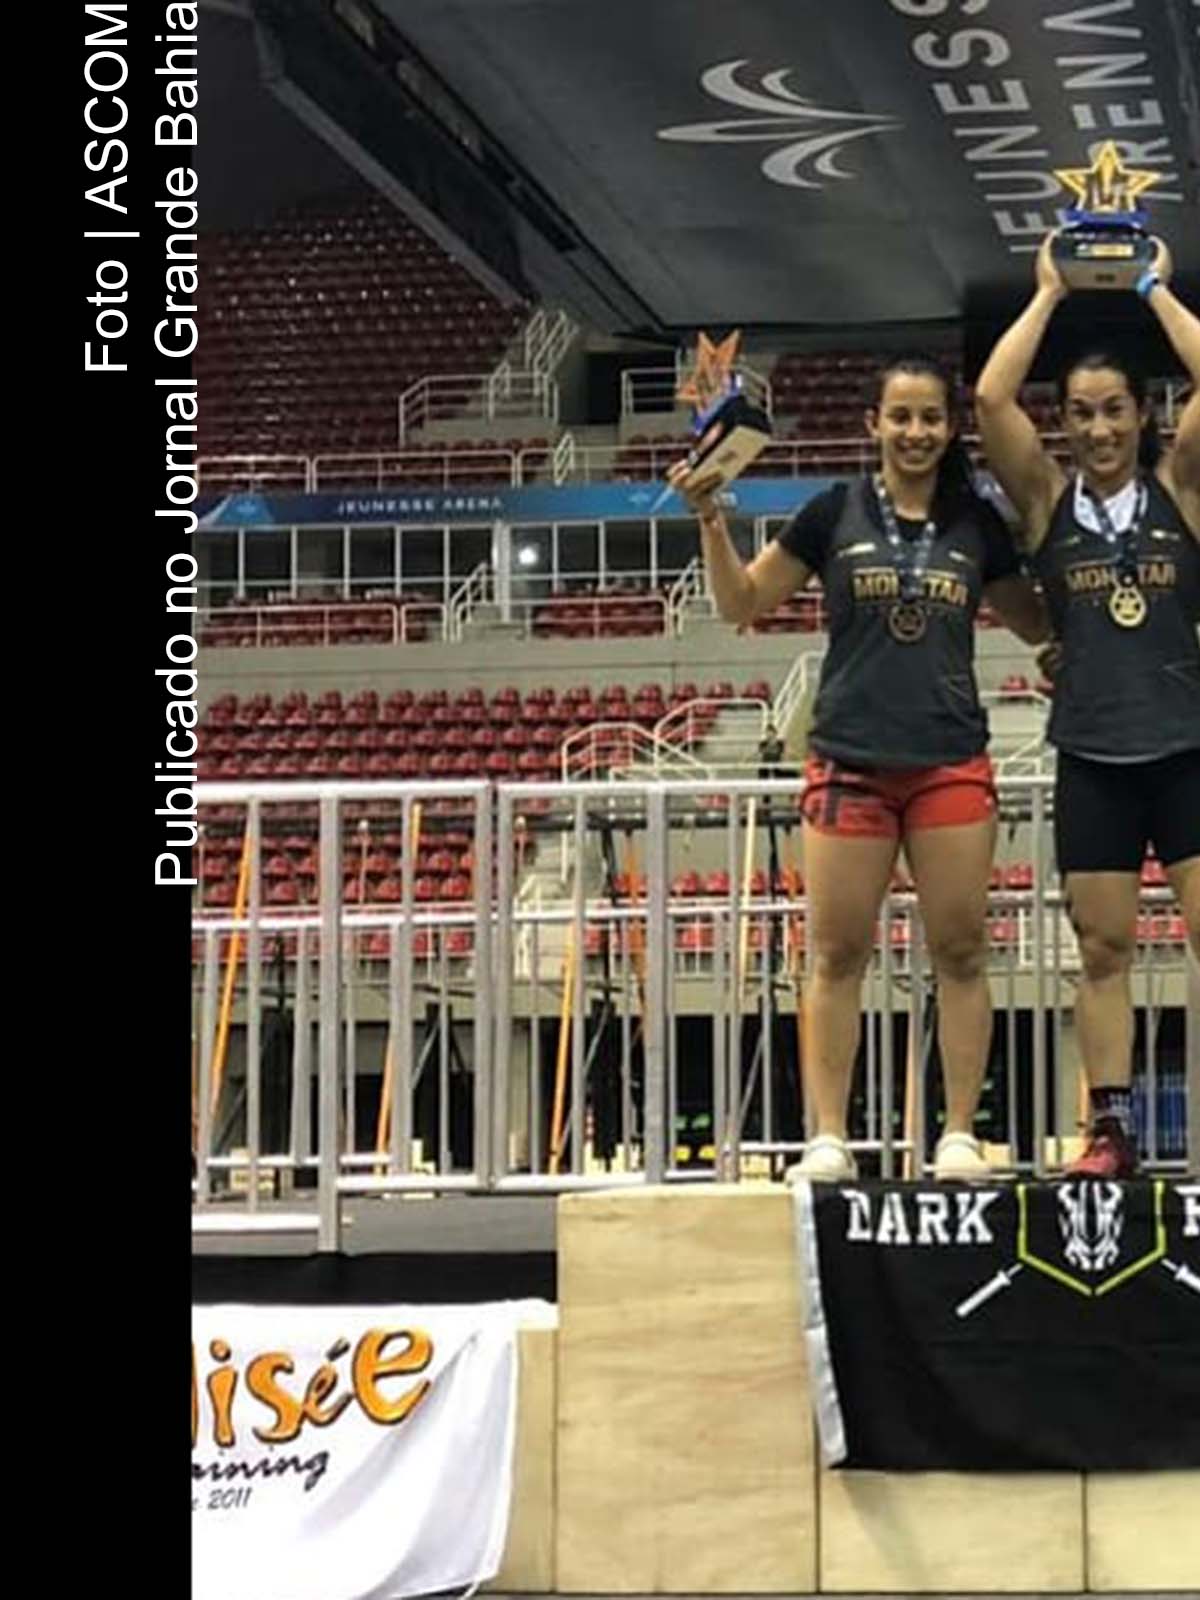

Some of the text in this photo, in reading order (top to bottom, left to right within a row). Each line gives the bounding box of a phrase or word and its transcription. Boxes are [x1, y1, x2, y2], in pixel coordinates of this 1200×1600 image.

[337, 498, 501, 515] JEUNESSE ARENA
[839, 1187, 999, 1246] DARK
[192, 1327, 435, 1450] isée
[207, 1486, 253, 1511] 2011
